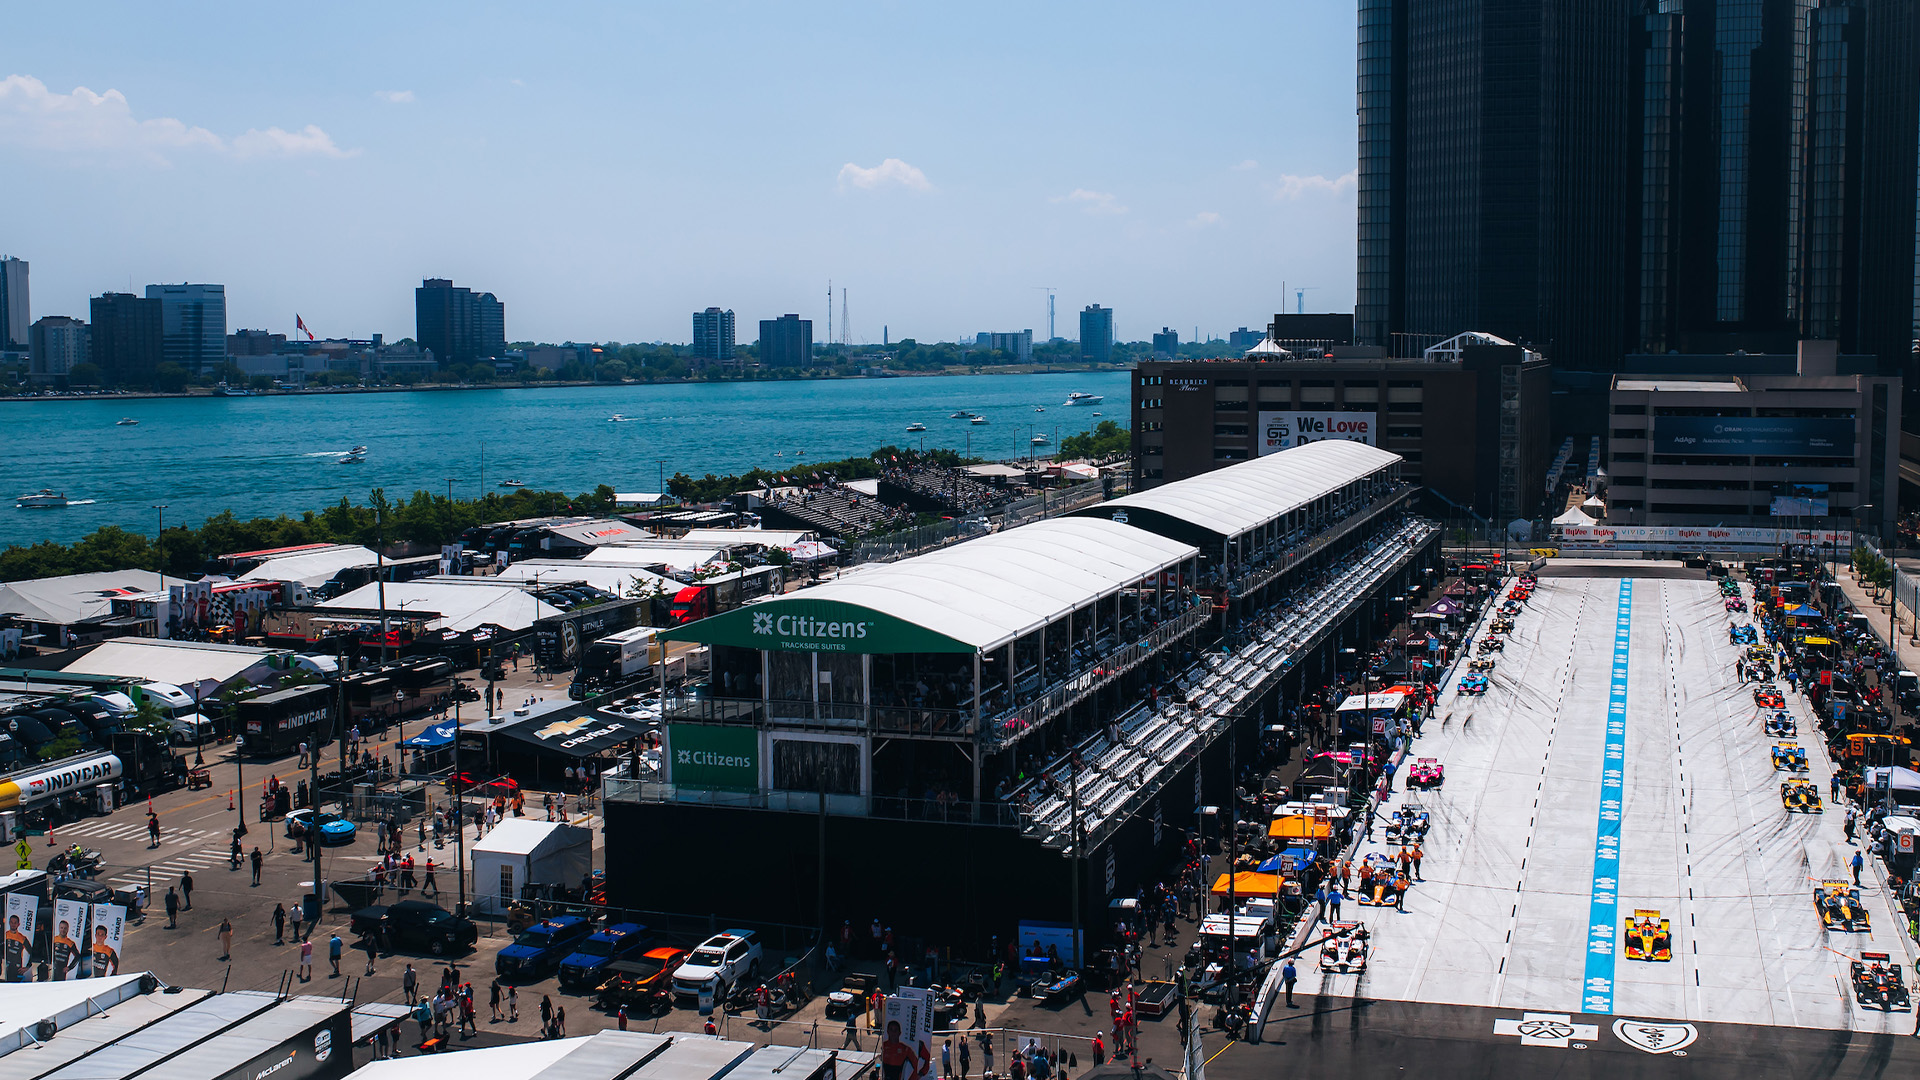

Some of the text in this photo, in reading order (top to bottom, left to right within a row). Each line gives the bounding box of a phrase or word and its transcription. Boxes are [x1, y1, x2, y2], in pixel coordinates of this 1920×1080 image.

[1266, 427, 1290, 439] GP
[1297, 417, 1368, 433] We Love
[1674, 436, 1696, 444] AdAge
[596, 528, 630, 537] IMSA
[776, 615, 867, 638] Citizens
[781, 641, 820, 649] TRACKSIDE
[287, 708, 327, 729] INDYCAR
[1836, 706, 1845, 716] 7
[560, 723, 625, 748] CHEVROLET
[1853, 741, 1861, 752] 5
[692, 751, 751, 768] Citizens
[45, 761, 112, 793] INDYCAR
[1901, 834, 1911, 848] 6
[1282, 862, 1292, 871] 30
[25, 910, 34, 932] ROSSI
[113, 916, 122, 941] O'WARD
[924, 993, 933, 1034] FERRUCCI
[909, 1005, 918, 1042] PEDERSEN
[255, 1056, 293, 1080] McLaren
